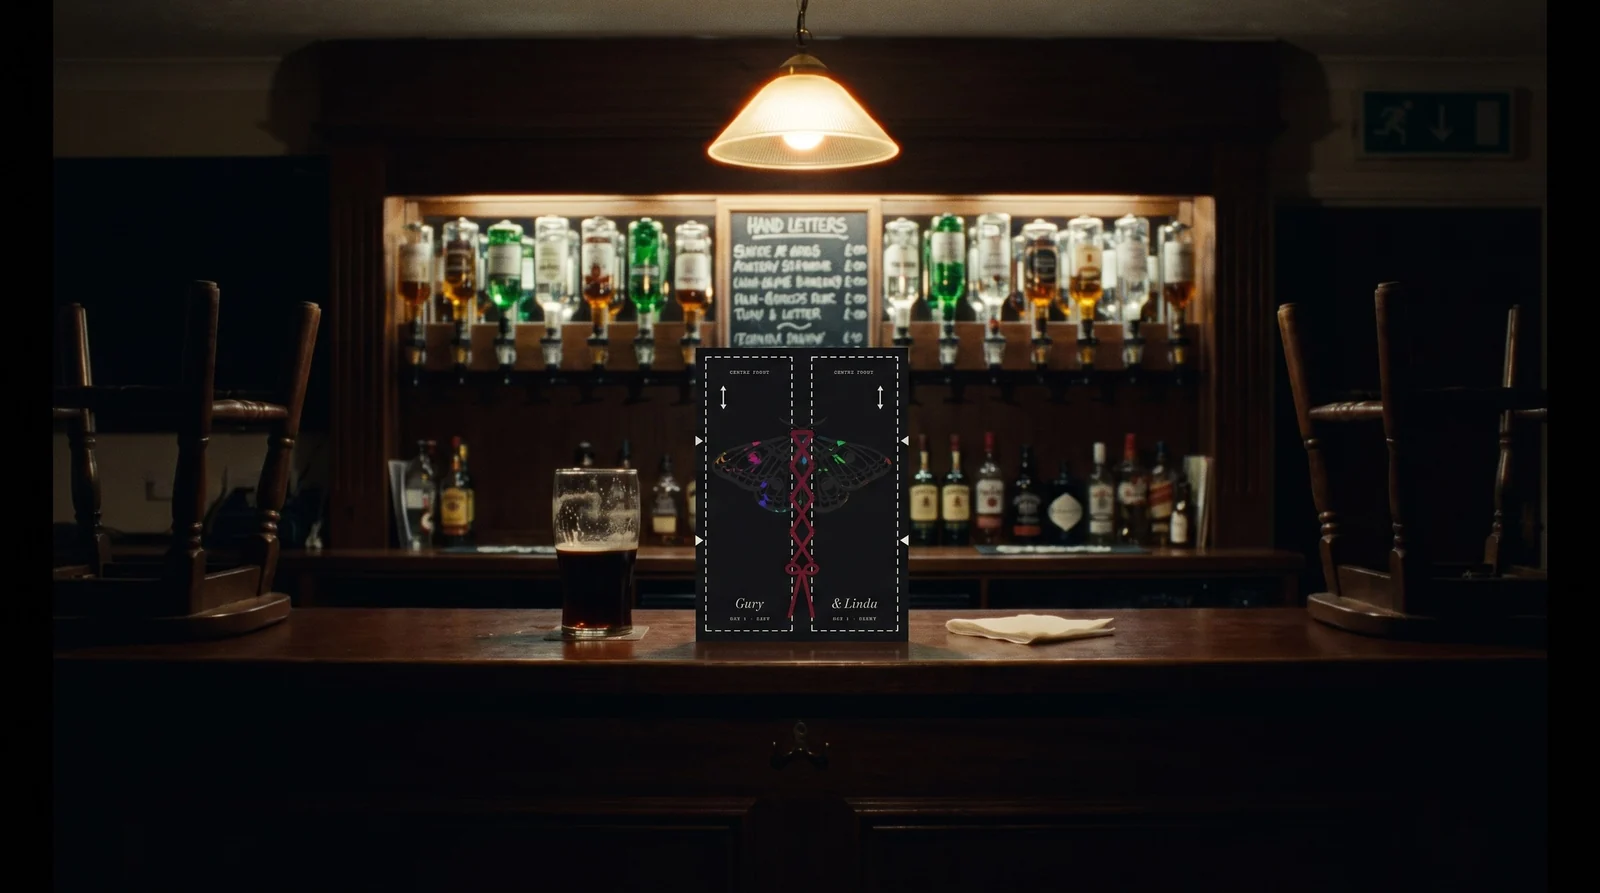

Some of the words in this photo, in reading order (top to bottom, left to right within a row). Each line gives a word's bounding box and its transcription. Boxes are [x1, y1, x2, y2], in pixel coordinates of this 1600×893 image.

[747, 216, 784, 235] HAND
[787, 216, 849, 234] LETTERS
[781, 307, 822, 321] LETTER
[831, 597, 842, 609] &
[844, 597, 878, 609] Linda
